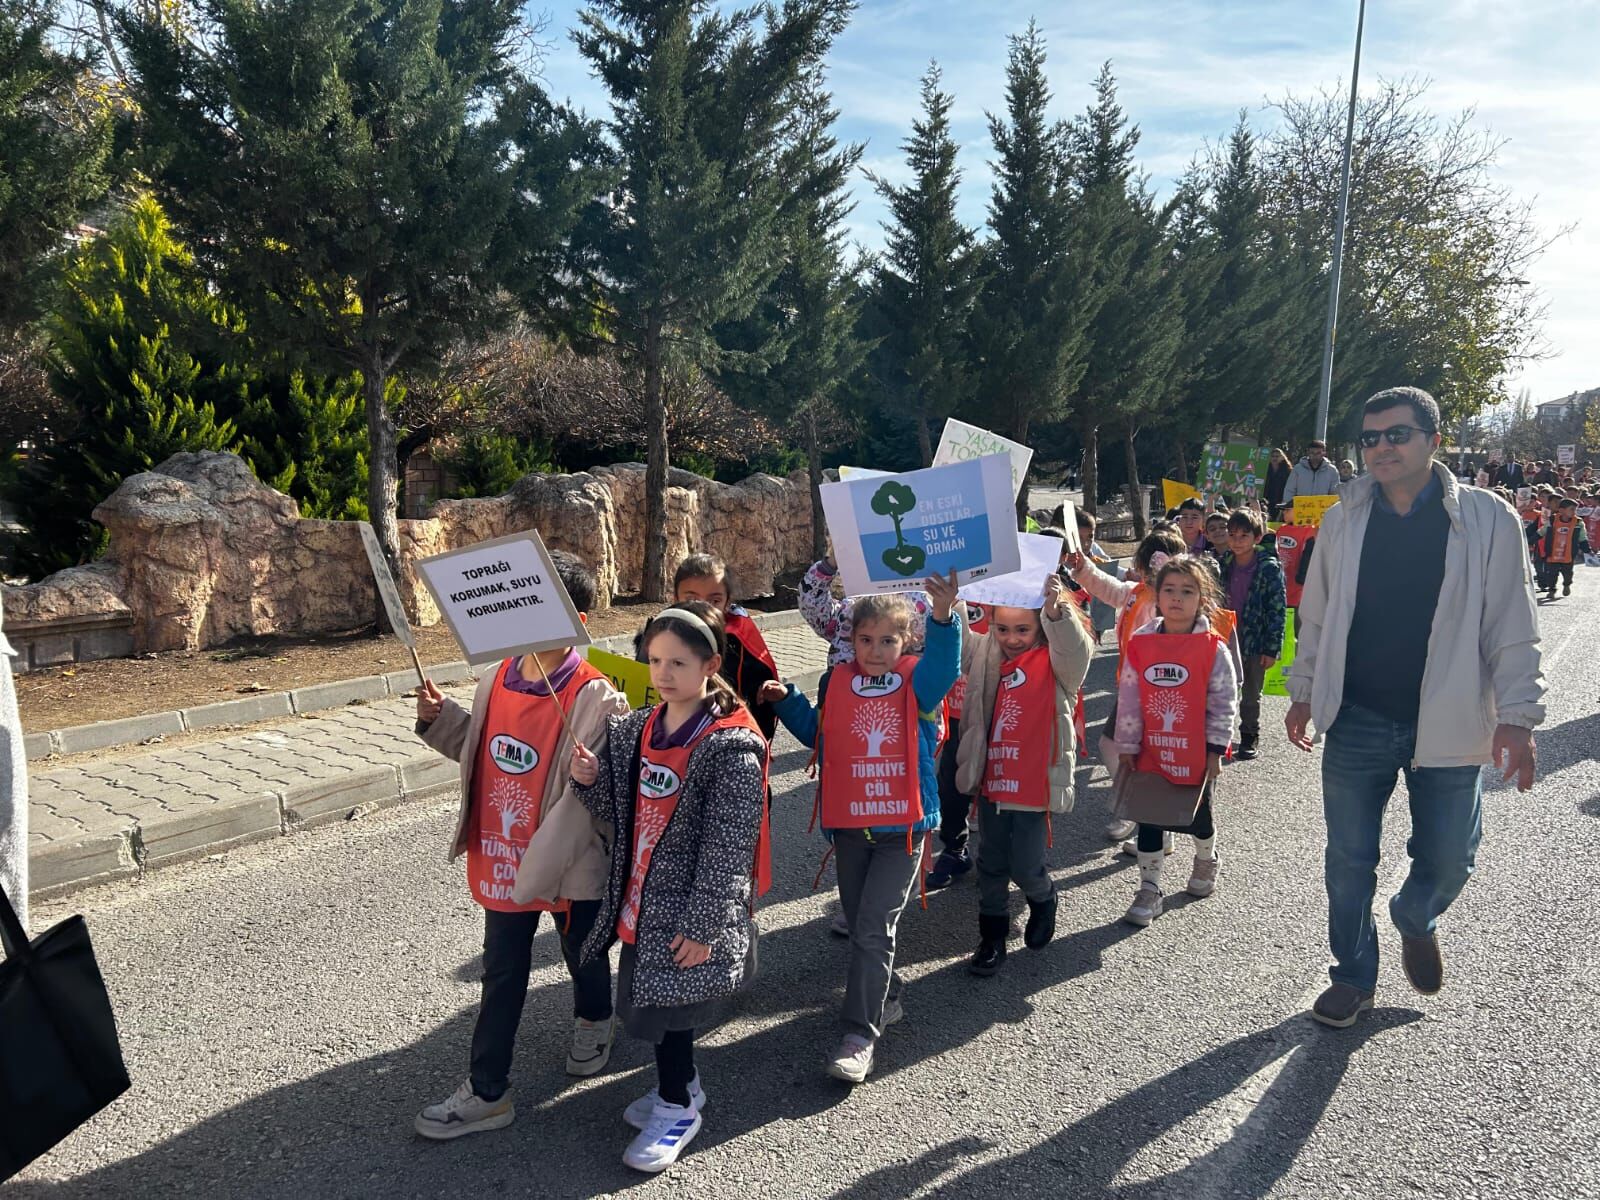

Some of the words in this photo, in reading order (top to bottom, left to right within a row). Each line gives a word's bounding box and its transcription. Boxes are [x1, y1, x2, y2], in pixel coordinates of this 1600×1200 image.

[919, 499, 934, 513] EN
[923, 527, 939, 541] SU
[941, 524, 957, 538] VE
[926, 536, 966, 556] ORMAN
[462, 561, 512, 580] TOPRAĞI
[450, 582, 510, 603] KORUMAK,
[510, 574, 542, 590] SUYU
[466, 594, 544, 618] KORUMAKTIR.
[860, 674, 886, 687] TEMA
[1154, 667, 1177, 678] TEMA
[497, 740, 522, 763] TEMA
[851, 760, 906, 778] TÜRKİYE
[865, 779, 892, 799] ÇÖL
[850, 800, 908, 816] OLMASIN
[480, 836, 527, 861] TÜRKİY
[480, 880, 514, 900] OLMA
